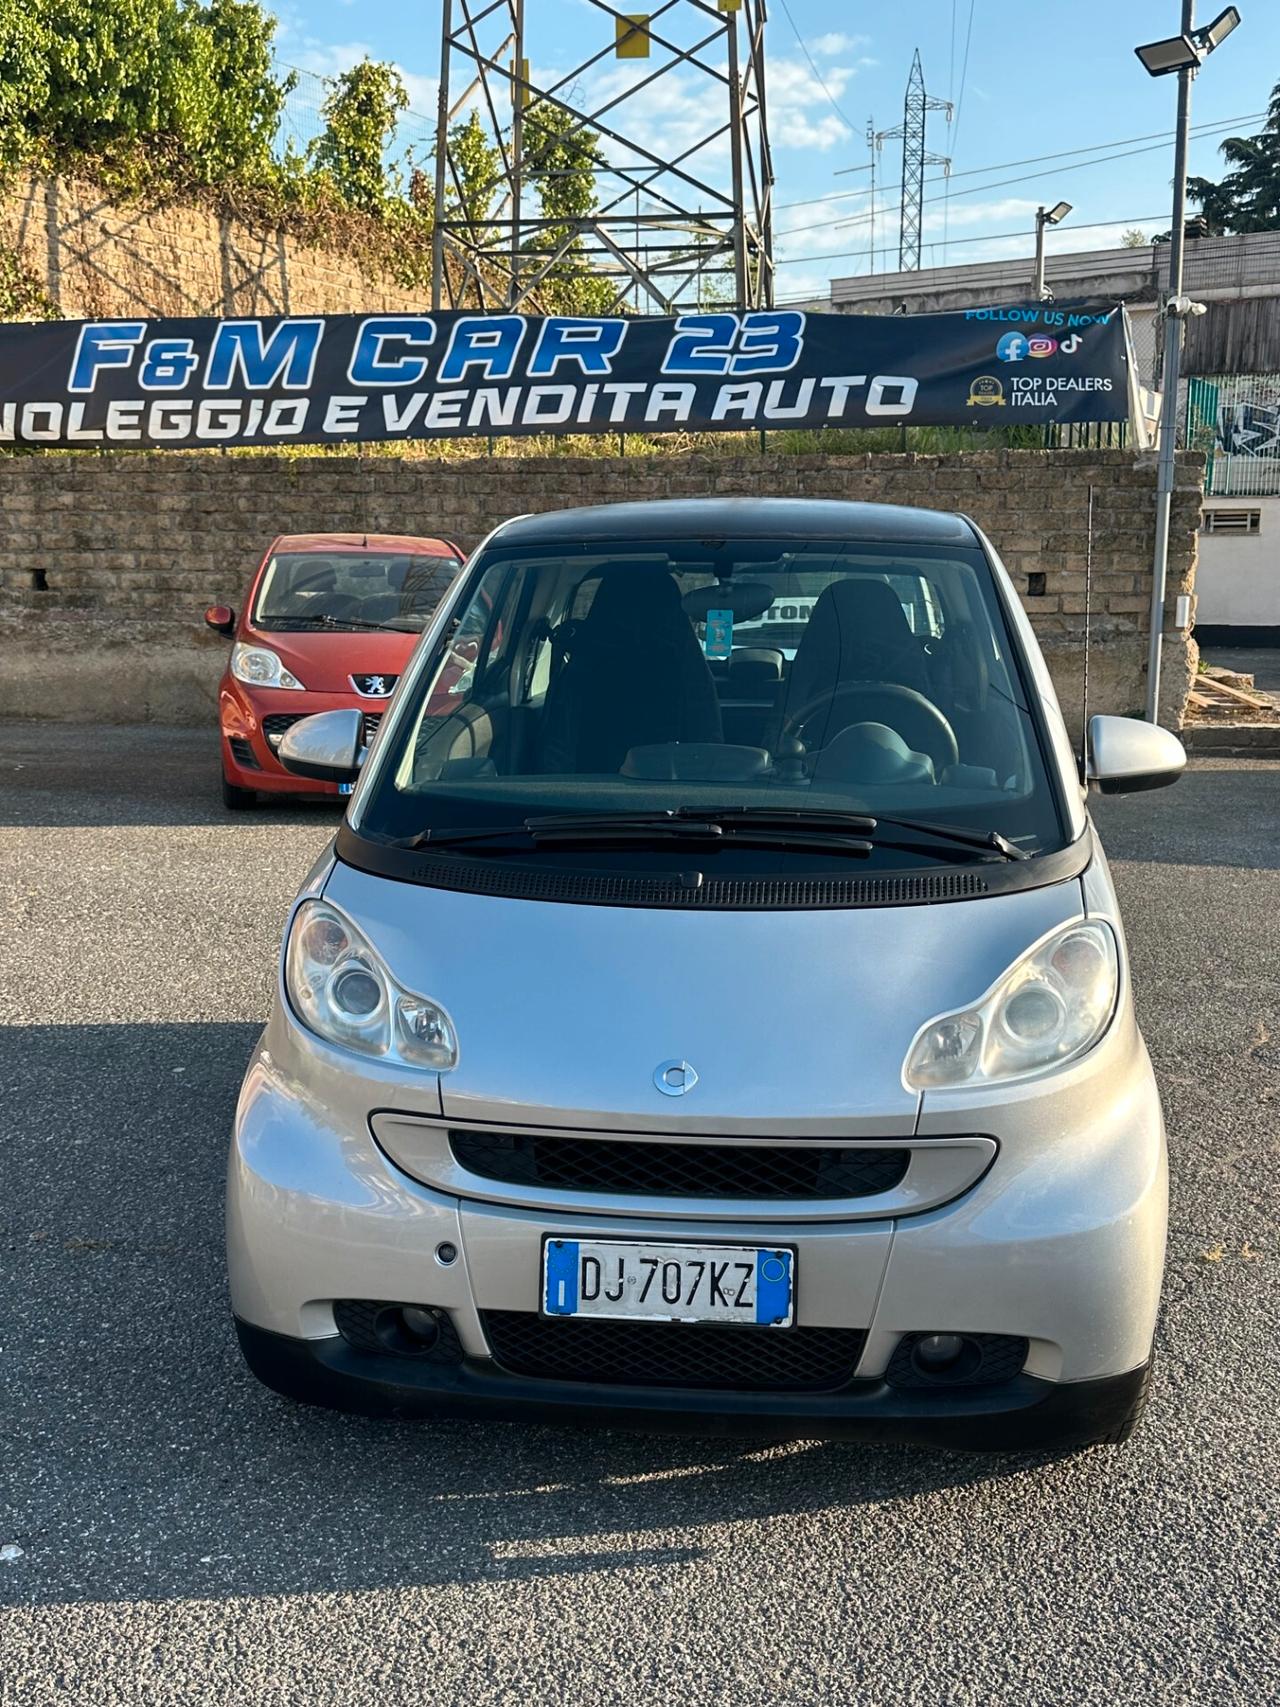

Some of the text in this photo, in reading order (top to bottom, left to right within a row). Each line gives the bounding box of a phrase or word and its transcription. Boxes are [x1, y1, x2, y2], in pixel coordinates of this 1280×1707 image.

[964, 309, 1111, 327] FOLLOW US NOW
[67, 310, 807, 393] F&M CAR 23
[1011, 377, 1113, 391] TOP DEALERS
[1011, 392, 1058, 406] ITALIA
[323, 395, 369, 433] E
[380, 382, 697, 433] VENDITA
[710, 375, 919, 421] AUTO
[581, 1256, 755, 1308] DJ 707KZ
